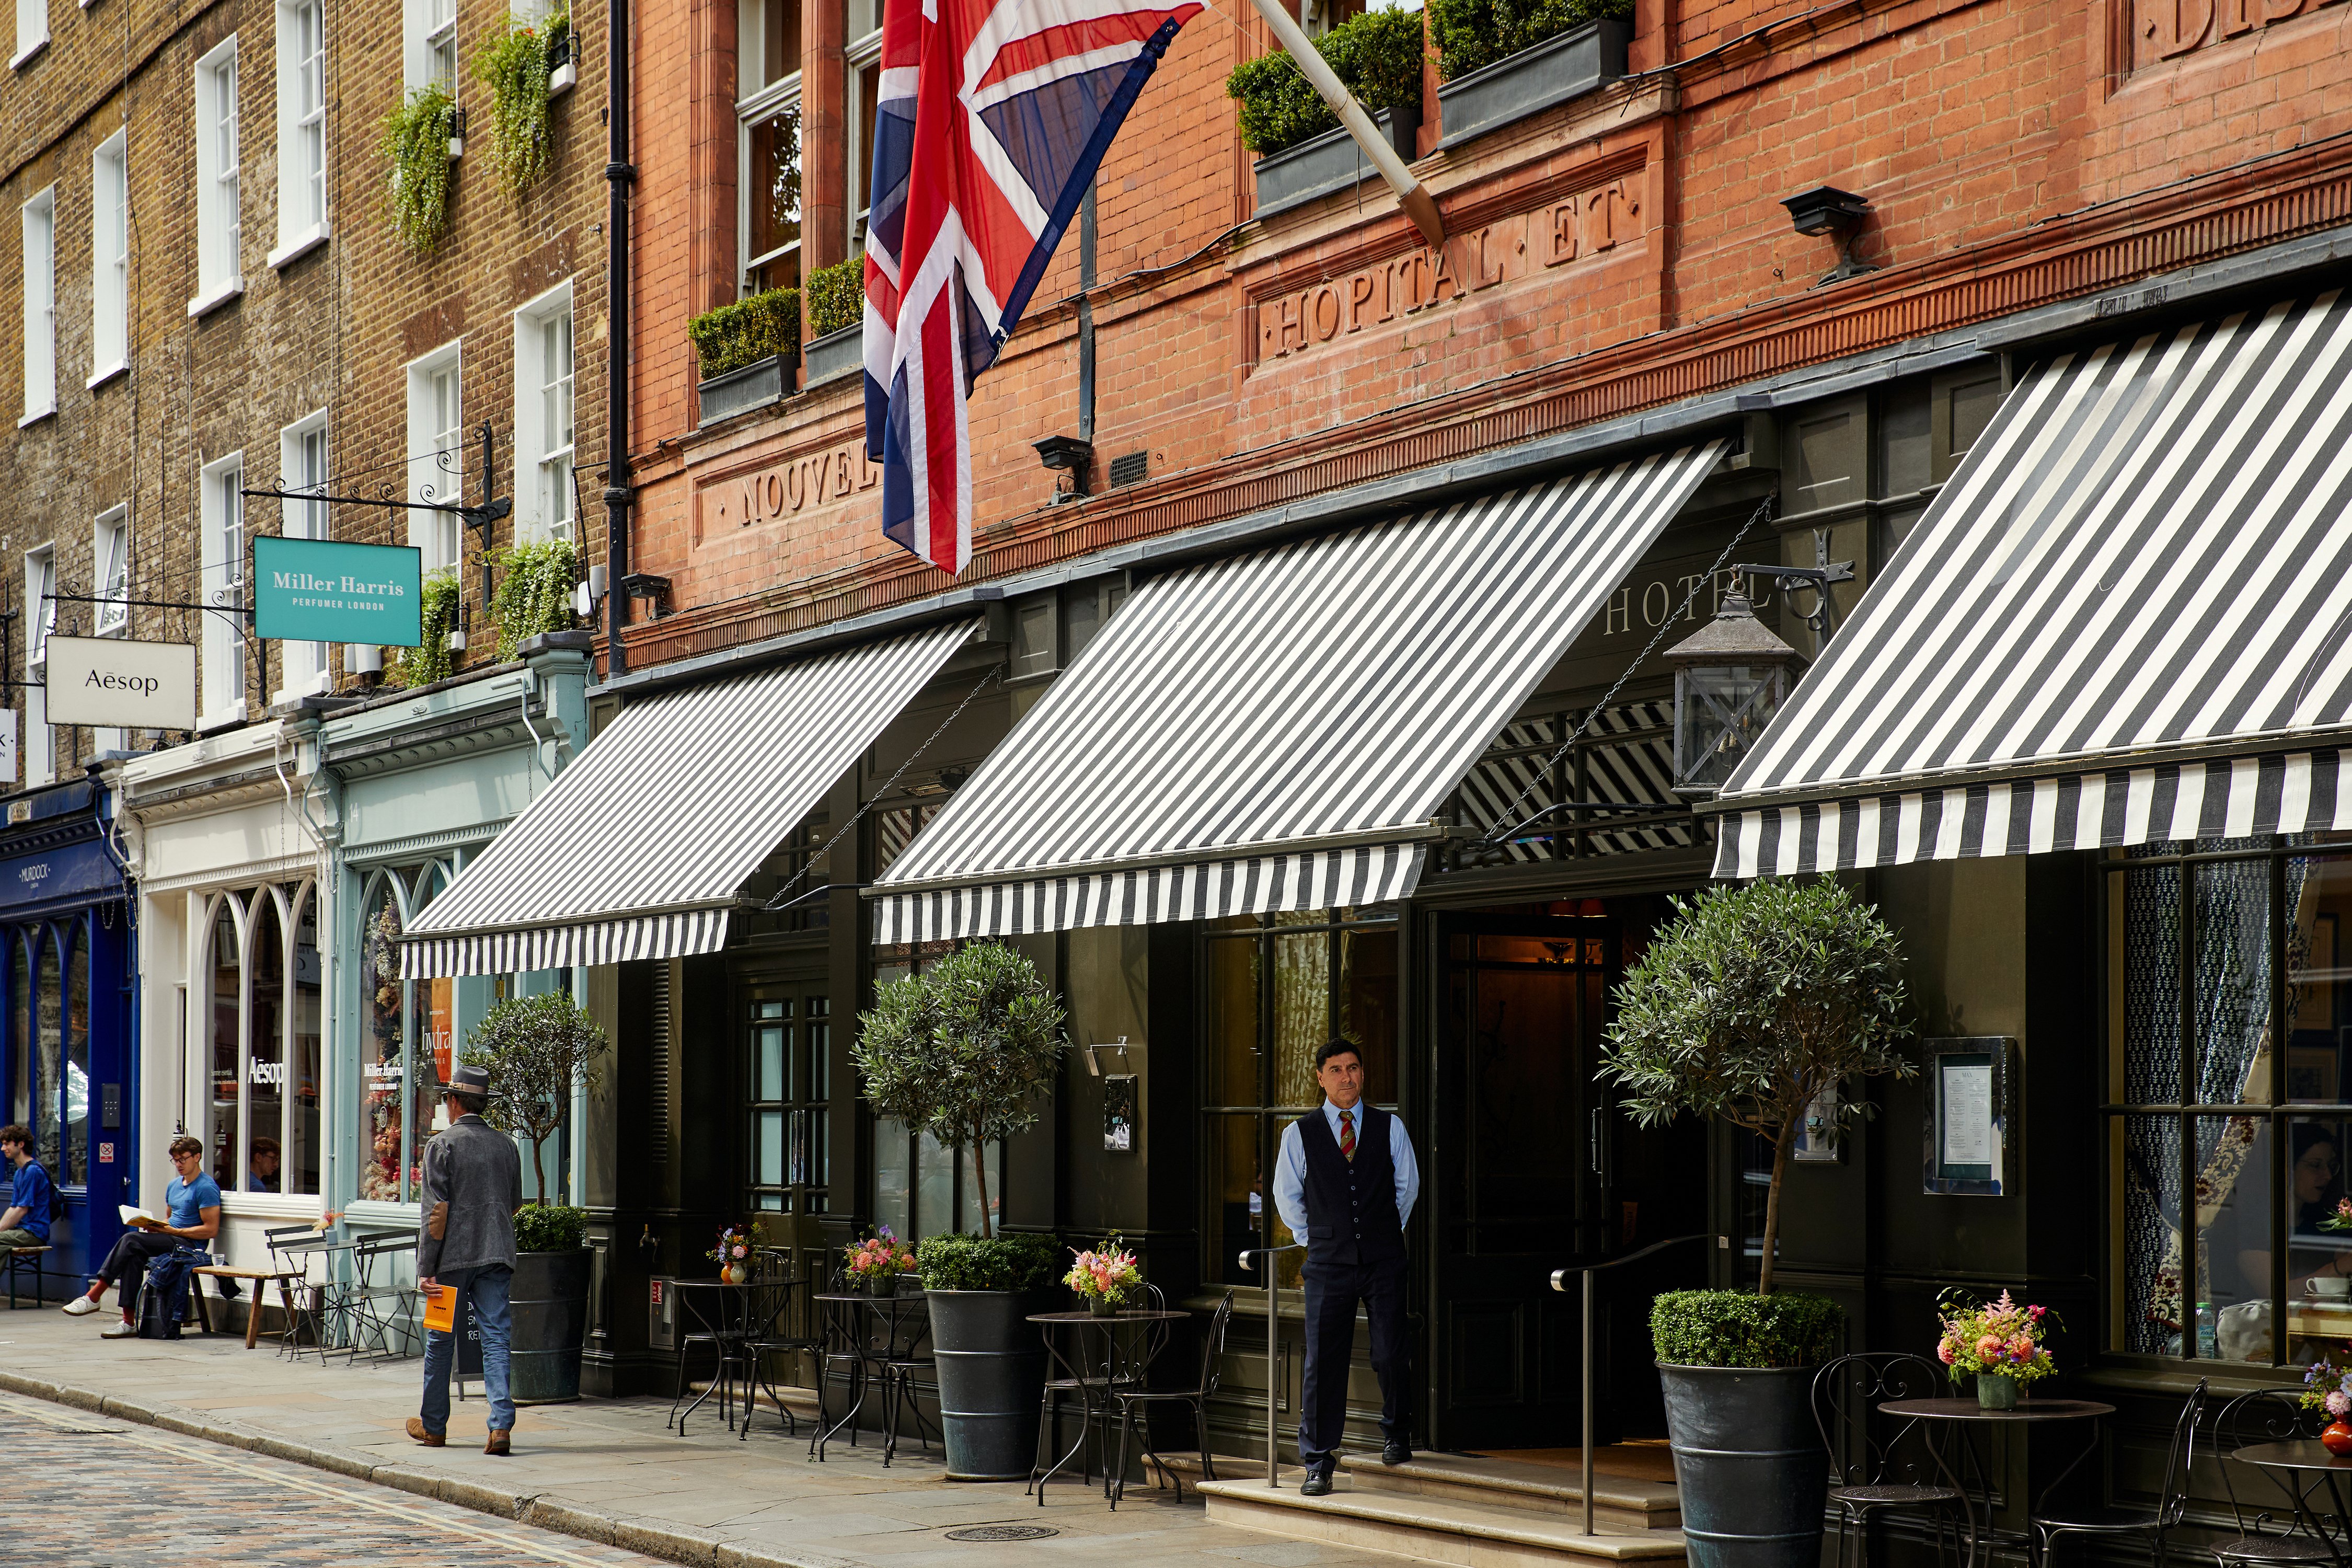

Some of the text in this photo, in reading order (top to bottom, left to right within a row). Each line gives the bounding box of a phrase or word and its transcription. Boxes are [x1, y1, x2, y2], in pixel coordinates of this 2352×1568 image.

[1544, 180, 1624, 268] ET
[273, 572, 404, 596] Miller Harris
[293, 597, 384, 611] PERFUMER LONDON
[1604, 563, 1771, 636] HOTEL
[349, 802, 359, 823] 14
[21, 863, 48, 883] MURDOCK
[422, 1024, 451, 1055] hydra
[364, 1063, 402, 1077] Miller Harris
